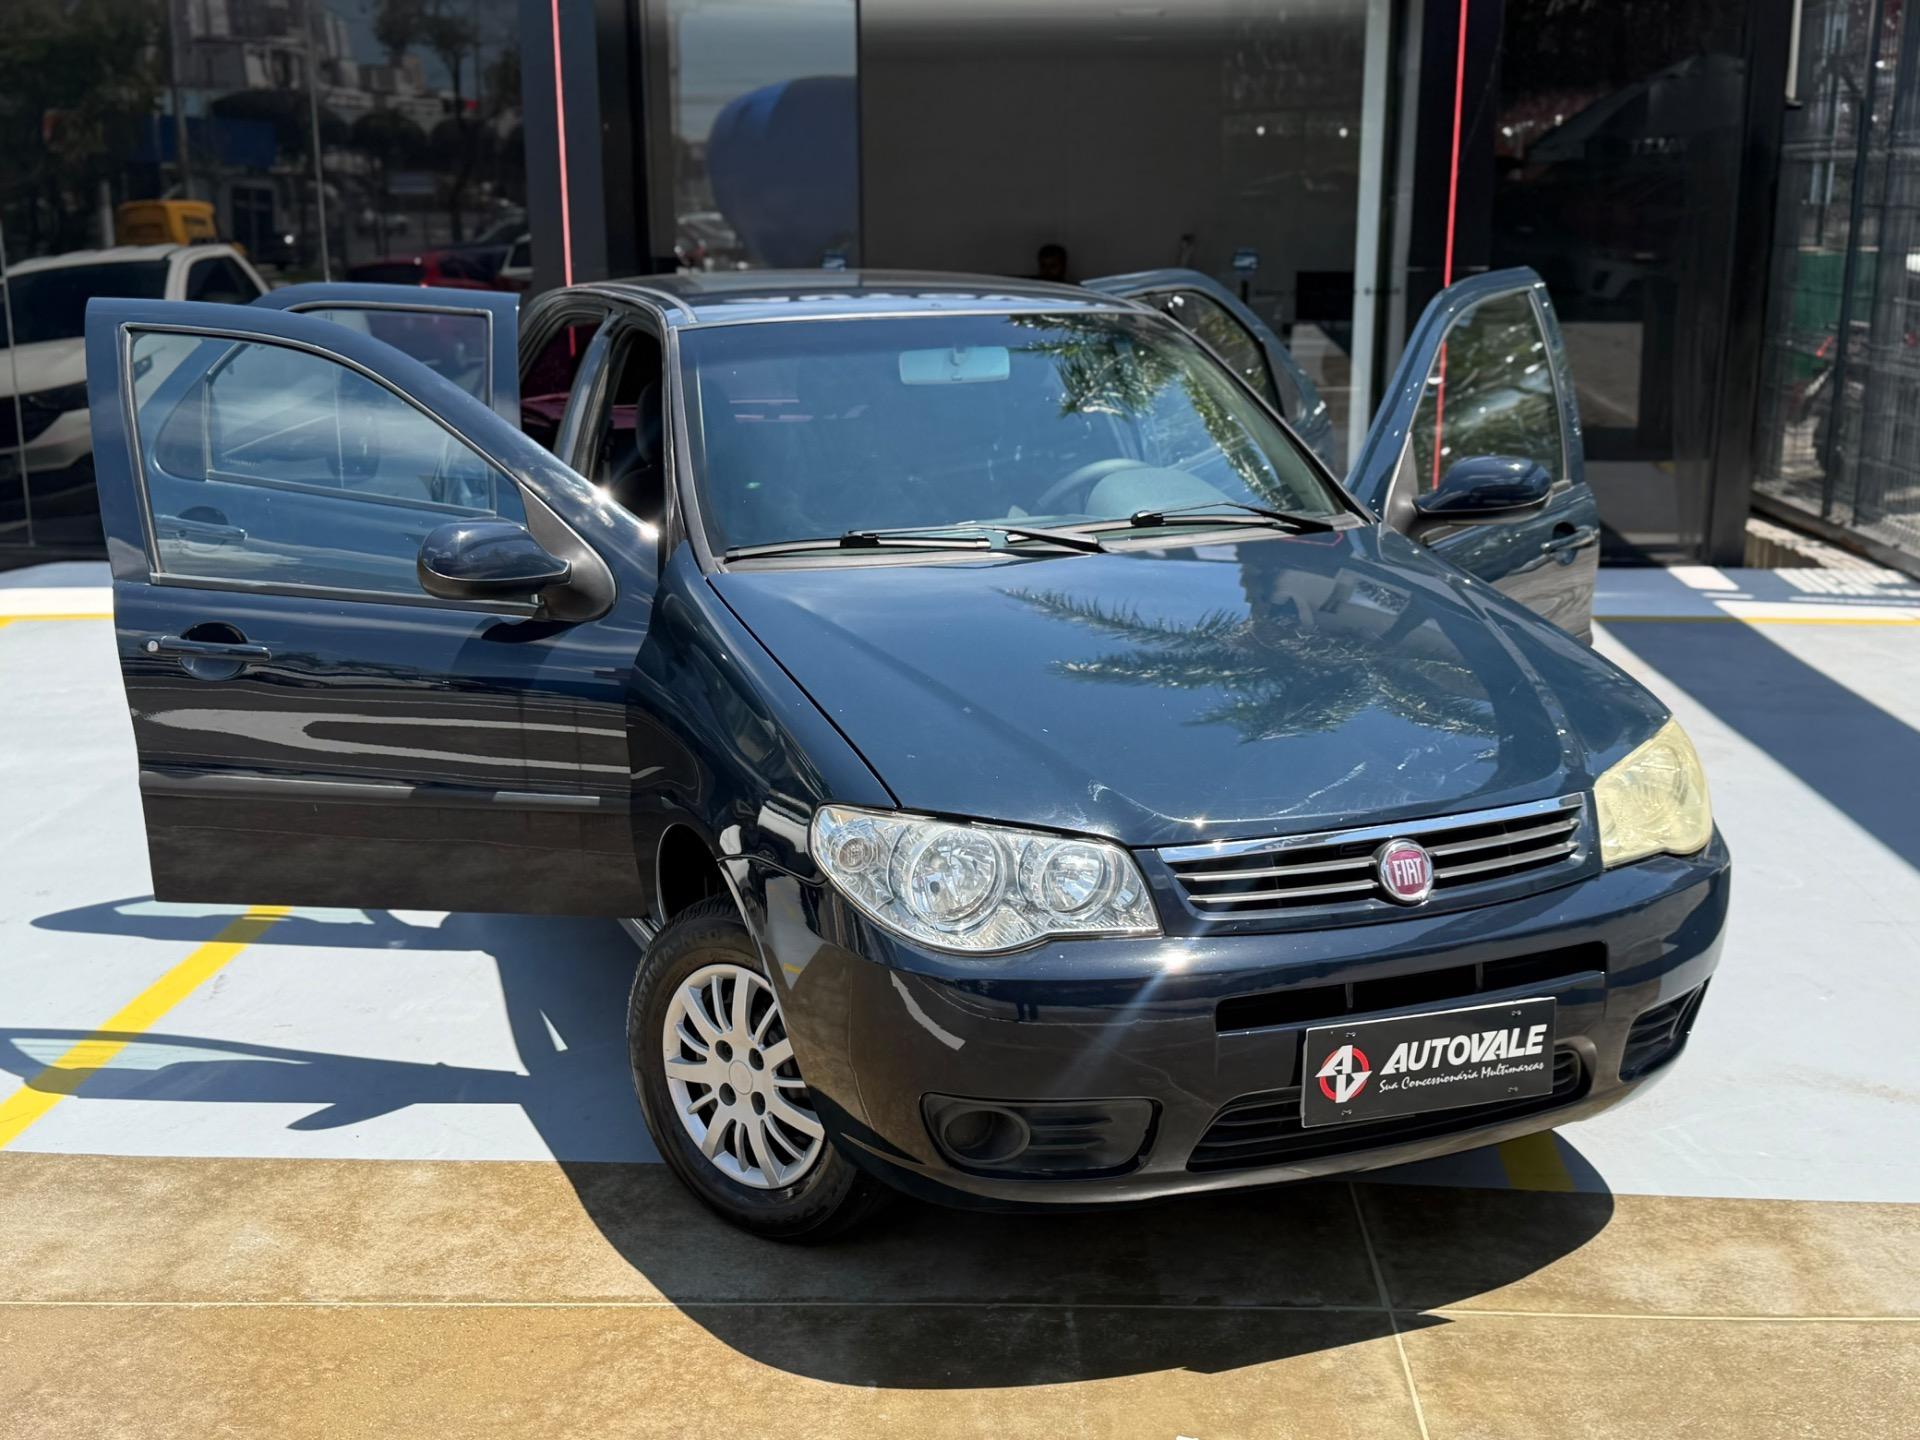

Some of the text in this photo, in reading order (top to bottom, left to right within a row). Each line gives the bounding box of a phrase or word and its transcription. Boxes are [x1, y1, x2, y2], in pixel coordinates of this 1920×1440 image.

[1392, 858, 1423, 887] FIAT
[1379, 1024, 1547, 1075] AUTOVALE
[1379, 1079, 1399, 1093] Sua
[1480, 1062, 1544, 1079] Multimarcas
